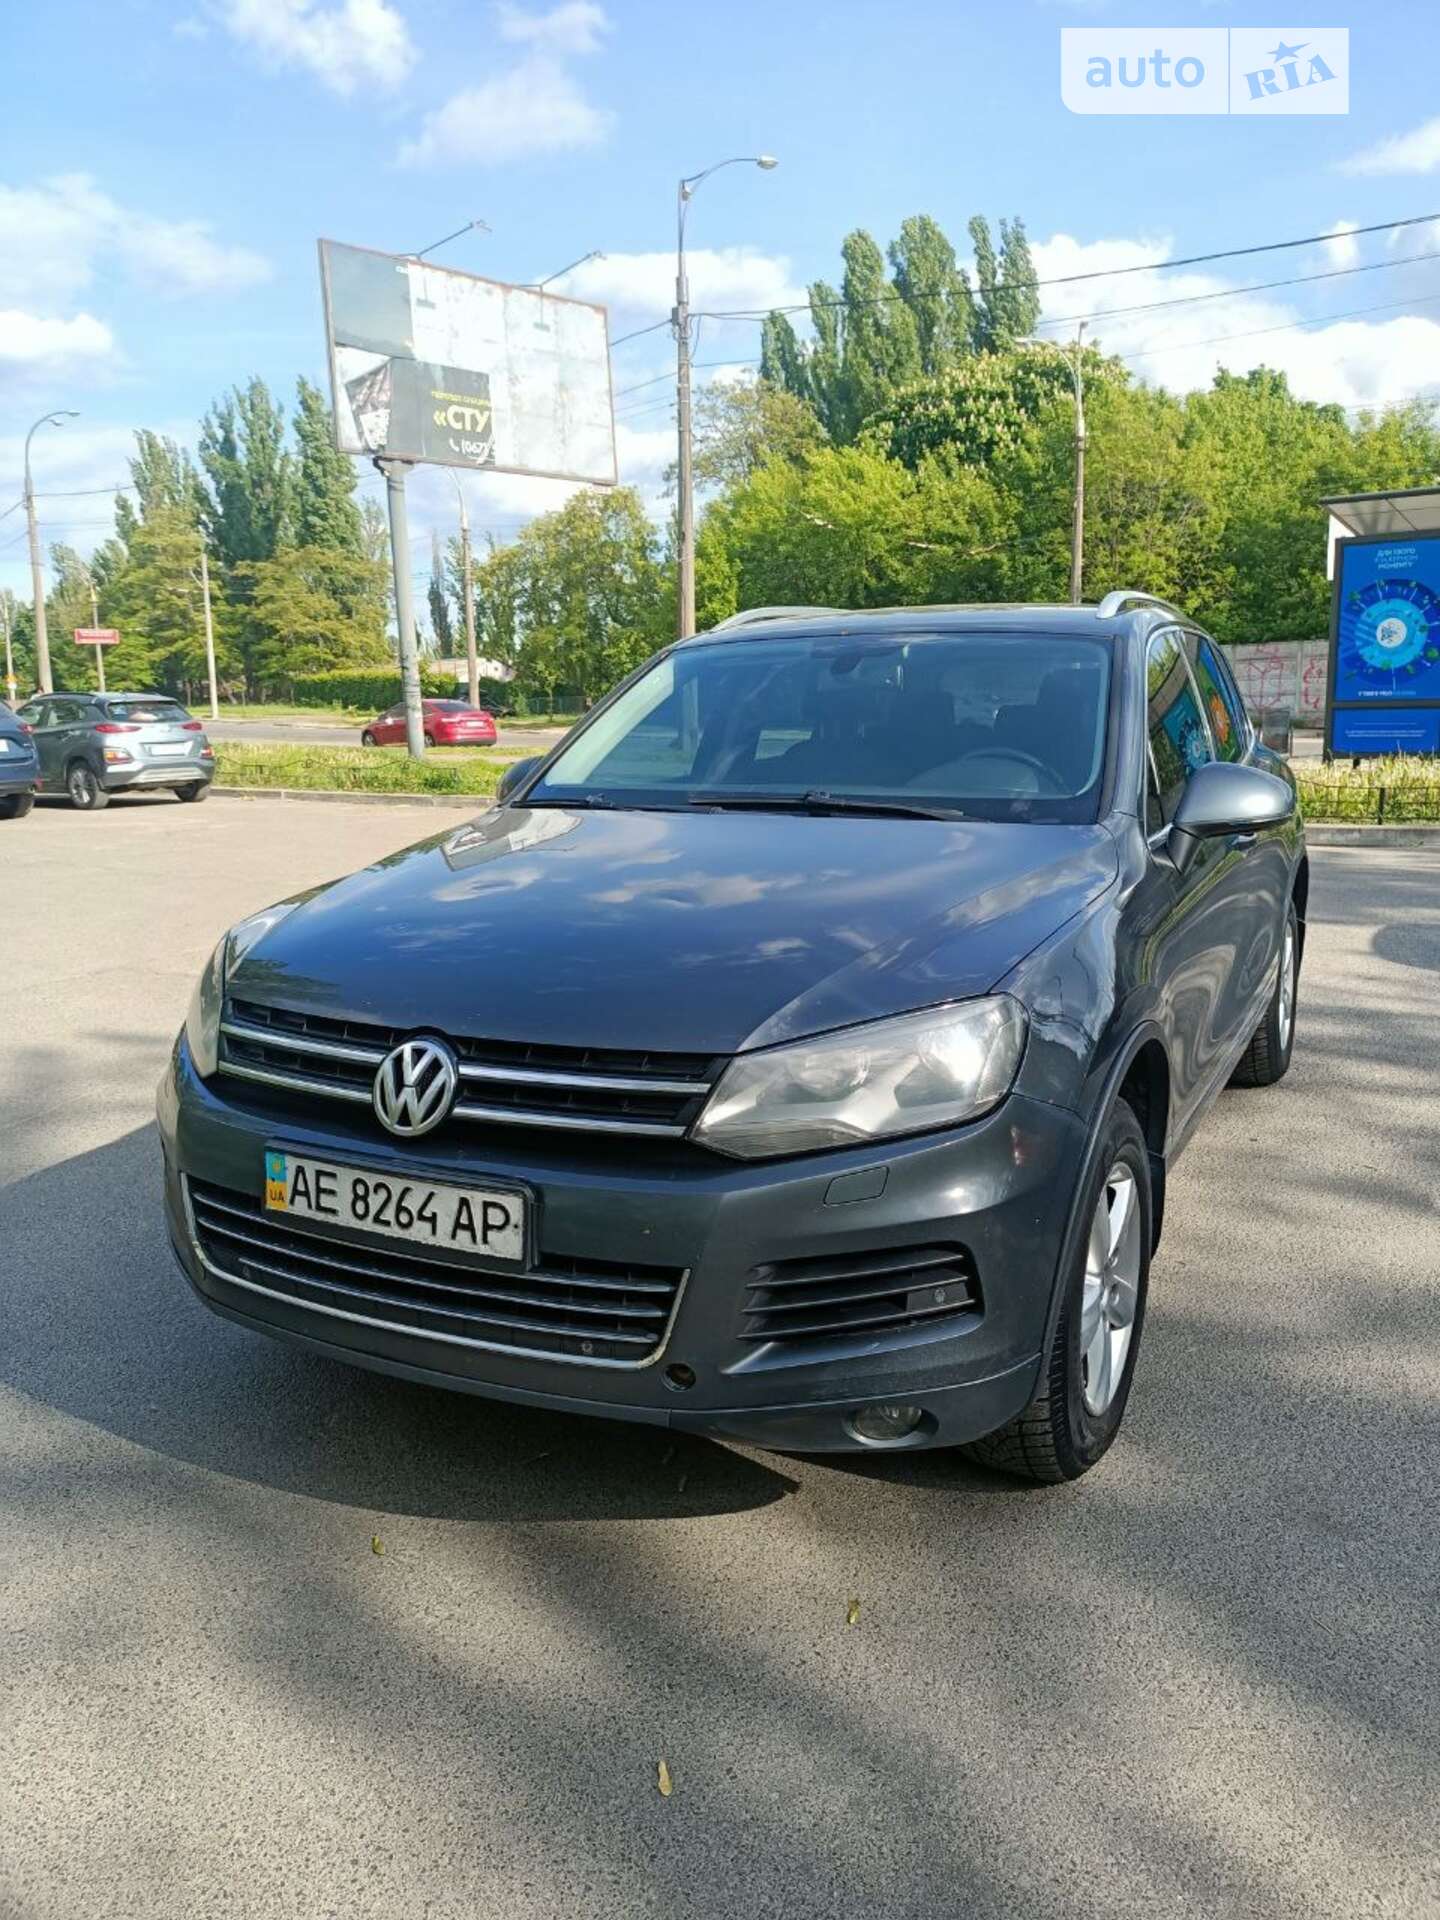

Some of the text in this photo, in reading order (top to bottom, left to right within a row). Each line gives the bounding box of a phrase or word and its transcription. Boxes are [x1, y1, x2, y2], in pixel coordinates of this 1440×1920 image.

[289, 1165, 511, 1245] AE 8264 AP
